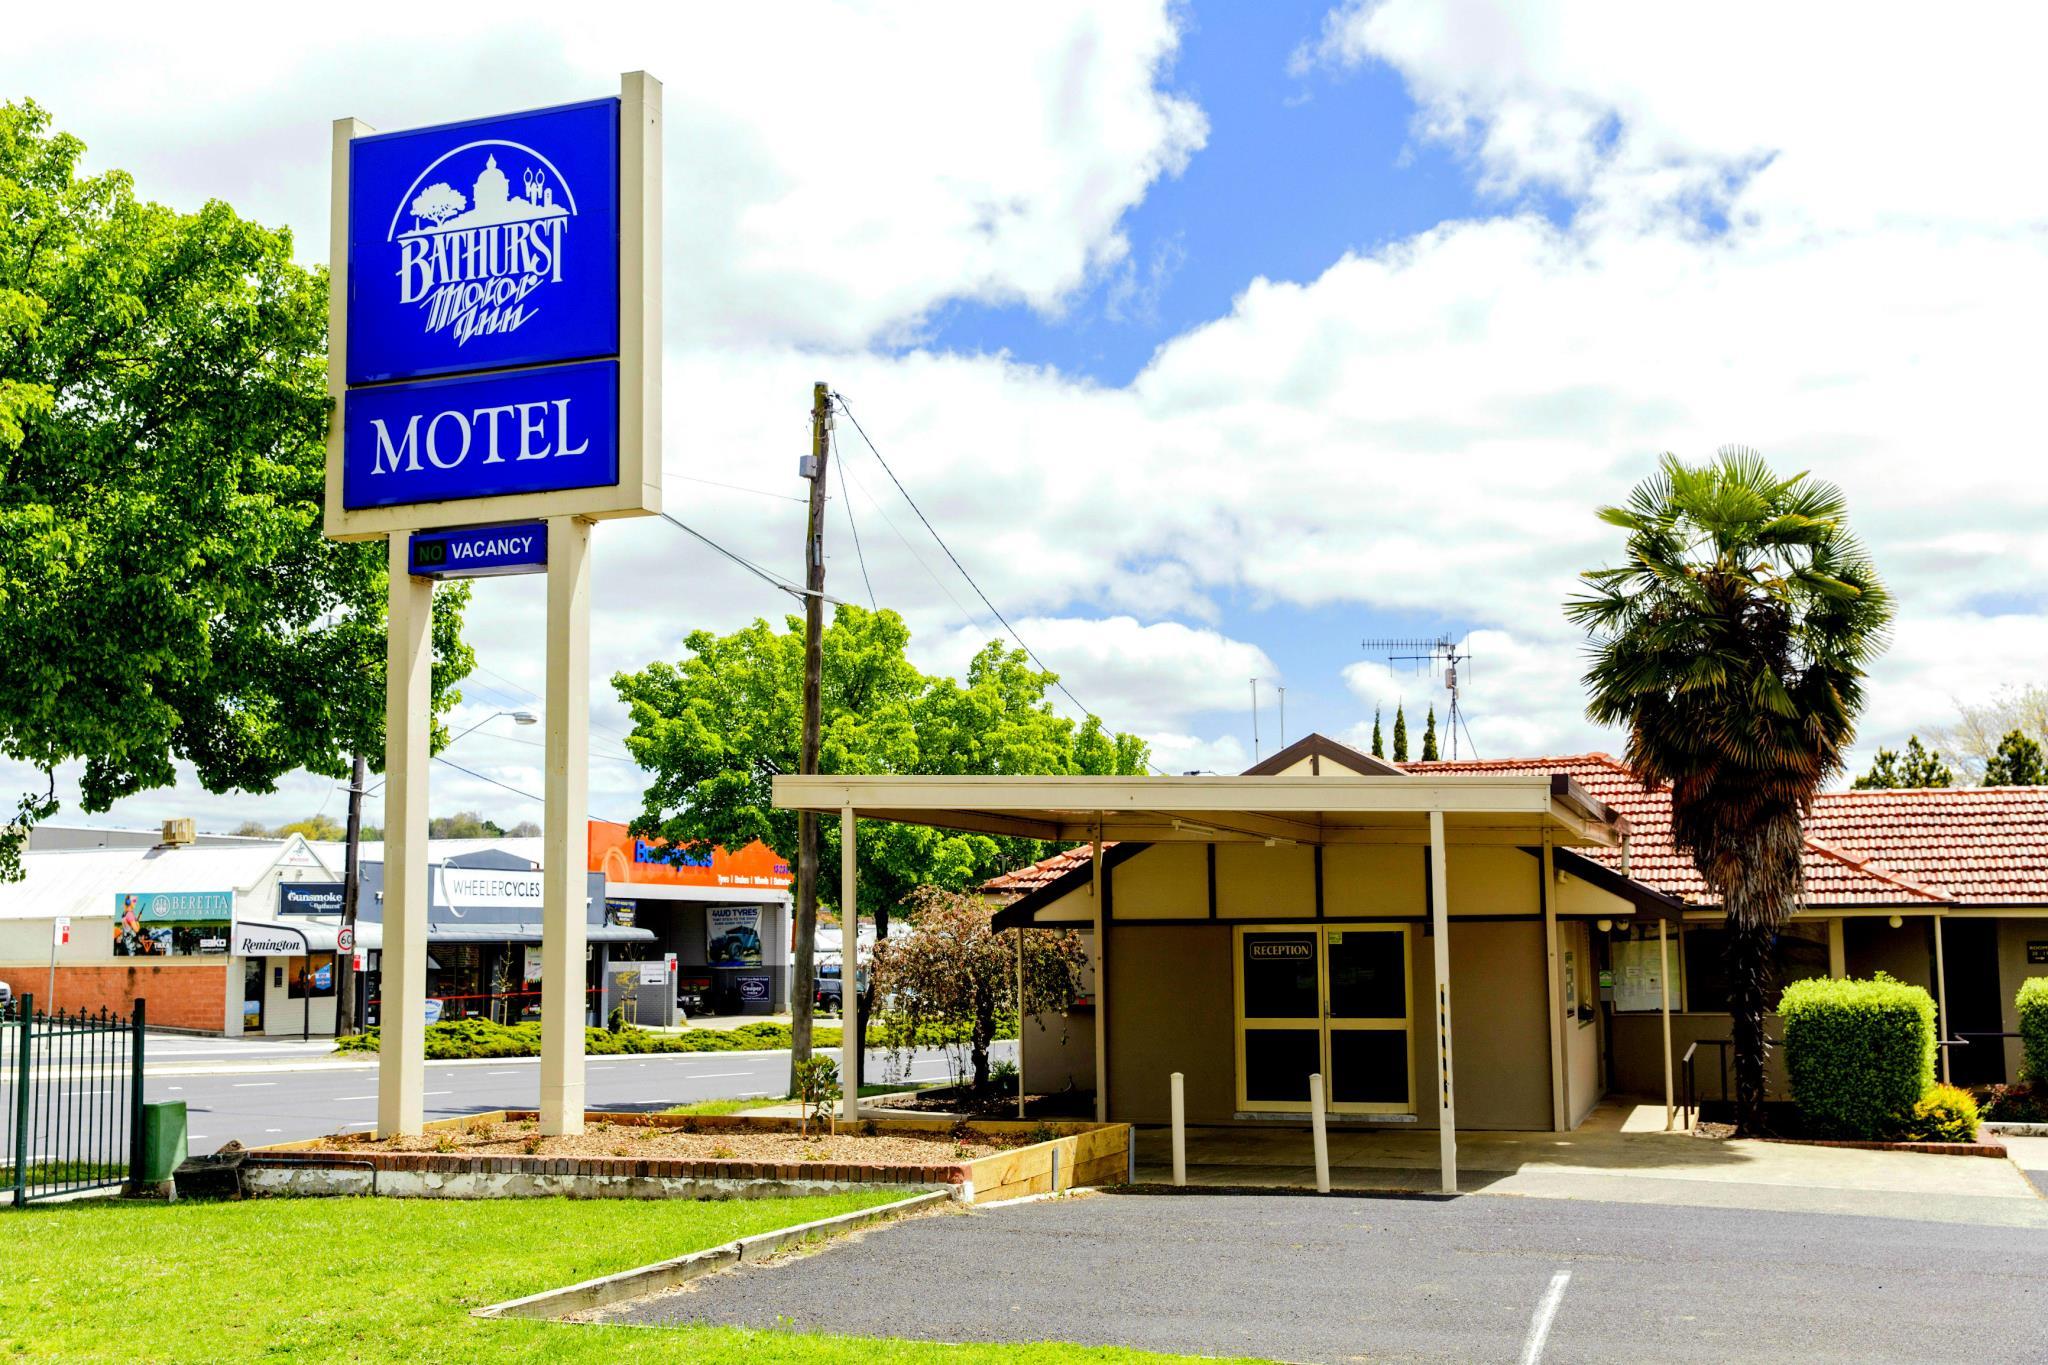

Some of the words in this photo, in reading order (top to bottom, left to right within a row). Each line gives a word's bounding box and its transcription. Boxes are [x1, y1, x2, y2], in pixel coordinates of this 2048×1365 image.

[396, 216, 568, 304] BATHURST
[419, 273, 544, 334] Motor
[453, 303, 539, 348] Inn
[370, 398, 590, 475] MOTEL
[419, 545, 443, 562] NO
[451, 536, 533, 559] VACANCY
[172, 895, 229, 910] BERETTA
[287, 891, 342, 902] Gunsmoke
[712, 909, 731, 917] 4WD
[732, 908, 758, 916] TYRES
[242, 938, 300, 953] Remington
[340, 935, 352, 945] 60
[1253, 945, 1309, 956] RECEPTION
